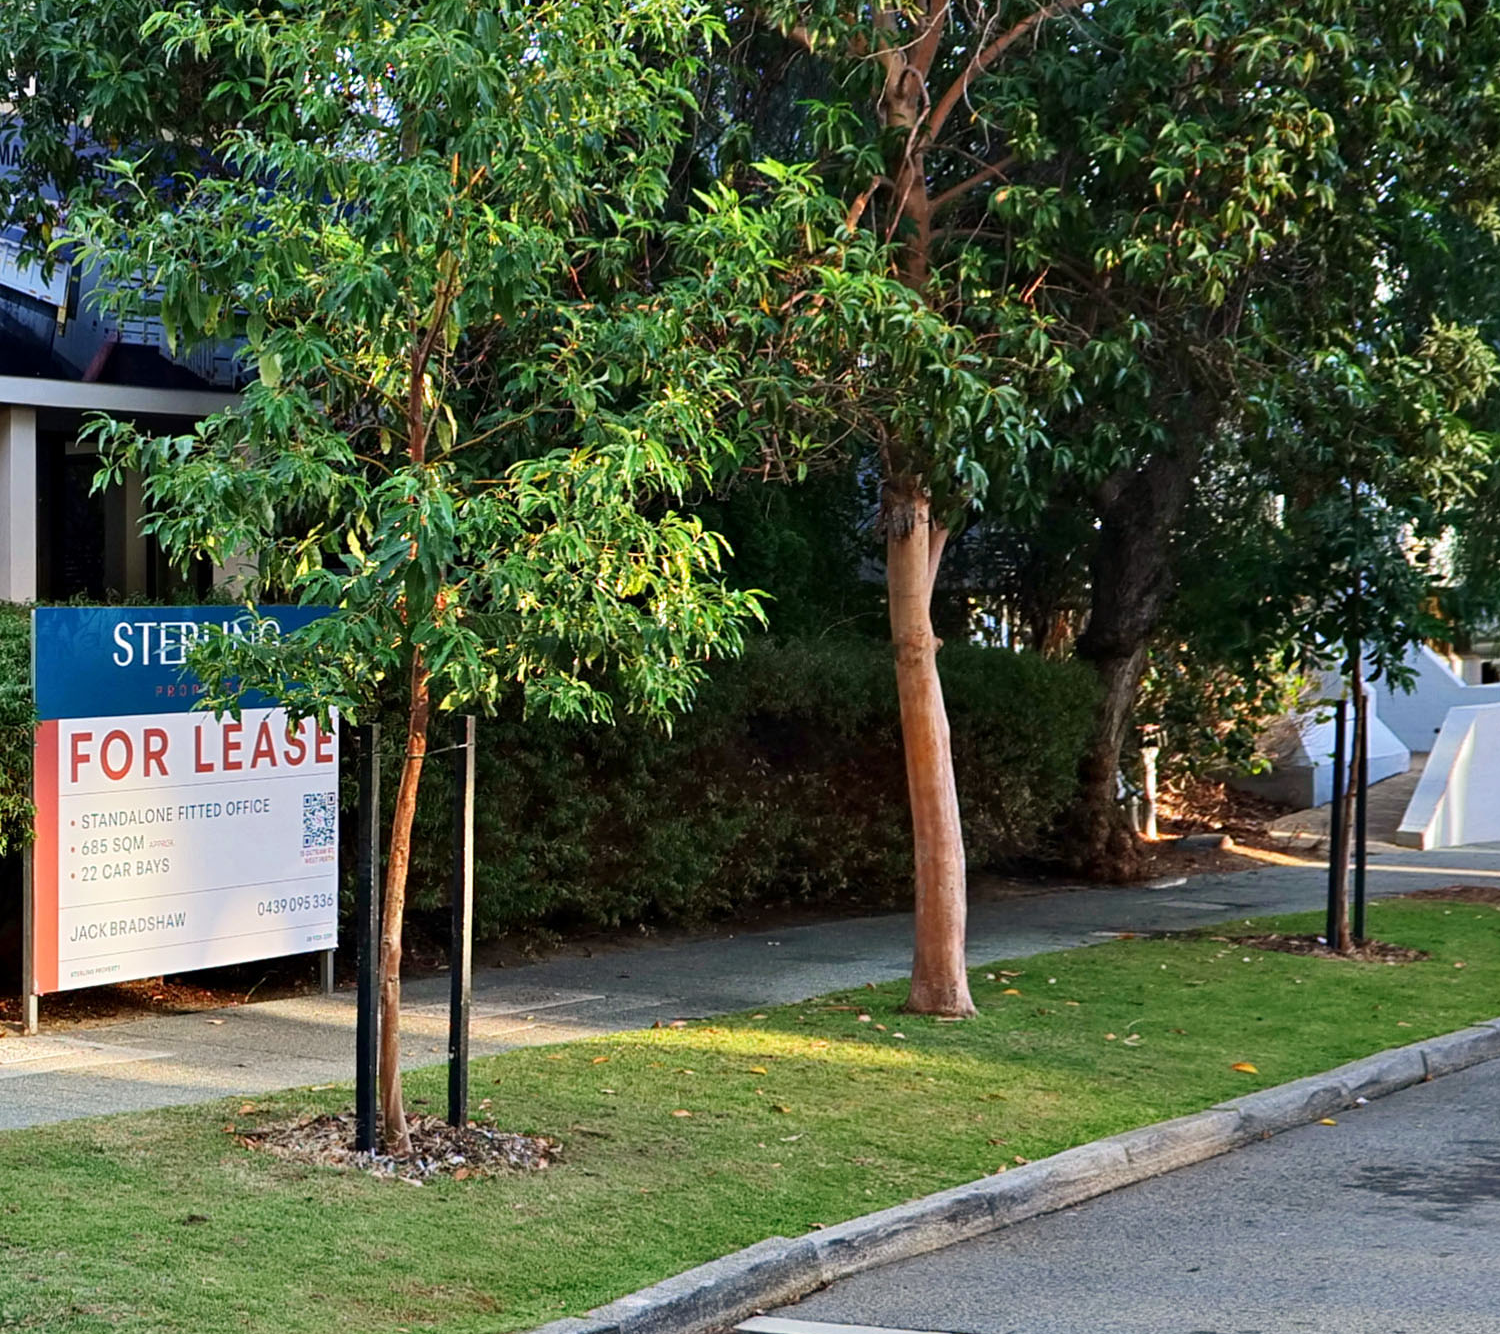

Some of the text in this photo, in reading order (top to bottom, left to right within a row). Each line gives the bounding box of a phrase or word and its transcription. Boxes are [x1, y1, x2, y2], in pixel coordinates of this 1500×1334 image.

[112, 620, 281, 667] STERNG
[156, 681, 244, 697] PROPT
[69, 717, 334, 783] FOR LEASE
[81, 798, 270, 829] STANDALONE FITTED OFFICE
[81, 838, 108, 856] 685
[113, 835, 145, 854] SQM
[81, 858, 170, 882] 22 CAR BAYS
[257, 893, 334, 916] 0439 095 336
[70, 911, 186, 942] JACK BRADSHAW
